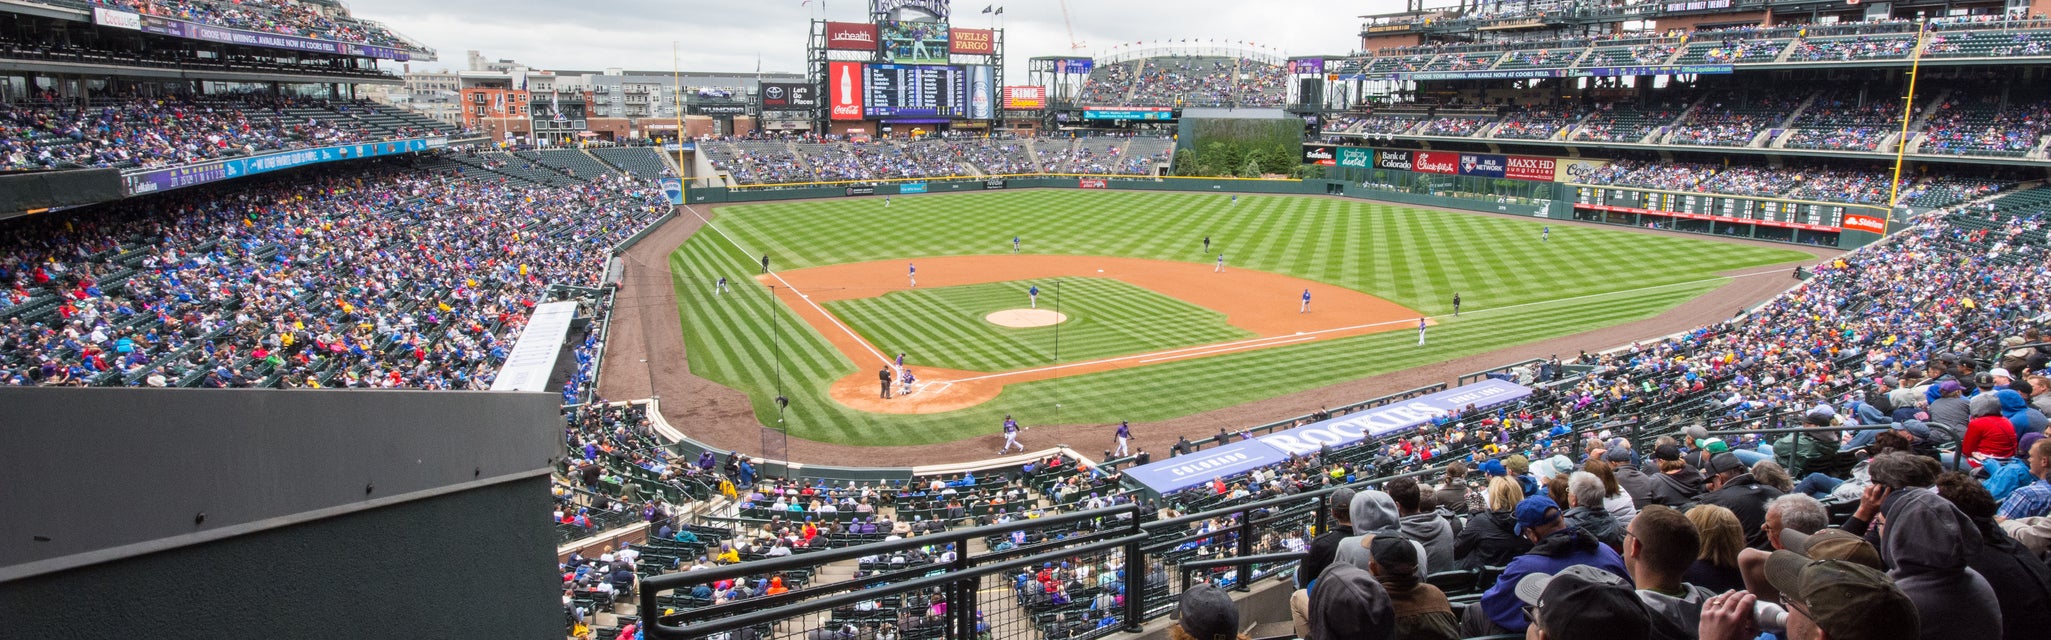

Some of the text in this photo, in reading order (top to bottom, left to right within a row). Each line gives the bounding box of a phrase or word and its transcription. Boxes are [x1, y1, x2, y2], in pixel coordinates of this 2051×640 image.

[834, 30, 870, 41] uchealth
[954, 31, 988, 42] WELLS
[286, 40, 298, 48] NOW
[955, 41, 988, 50] FARGO
[1012, 88, 1038, 98] KING
[834, 105, 859, 114] Coca-Cola
[1382, 152, 1406, 160] Bank of
[1382, 160, 1412, 169] Colorado
[1508, 158, 1554, 169] MAXX HD
[1260, 400, 1446, 454] ROCKIES
[1172, 452, 1248, 476] COLORADO
